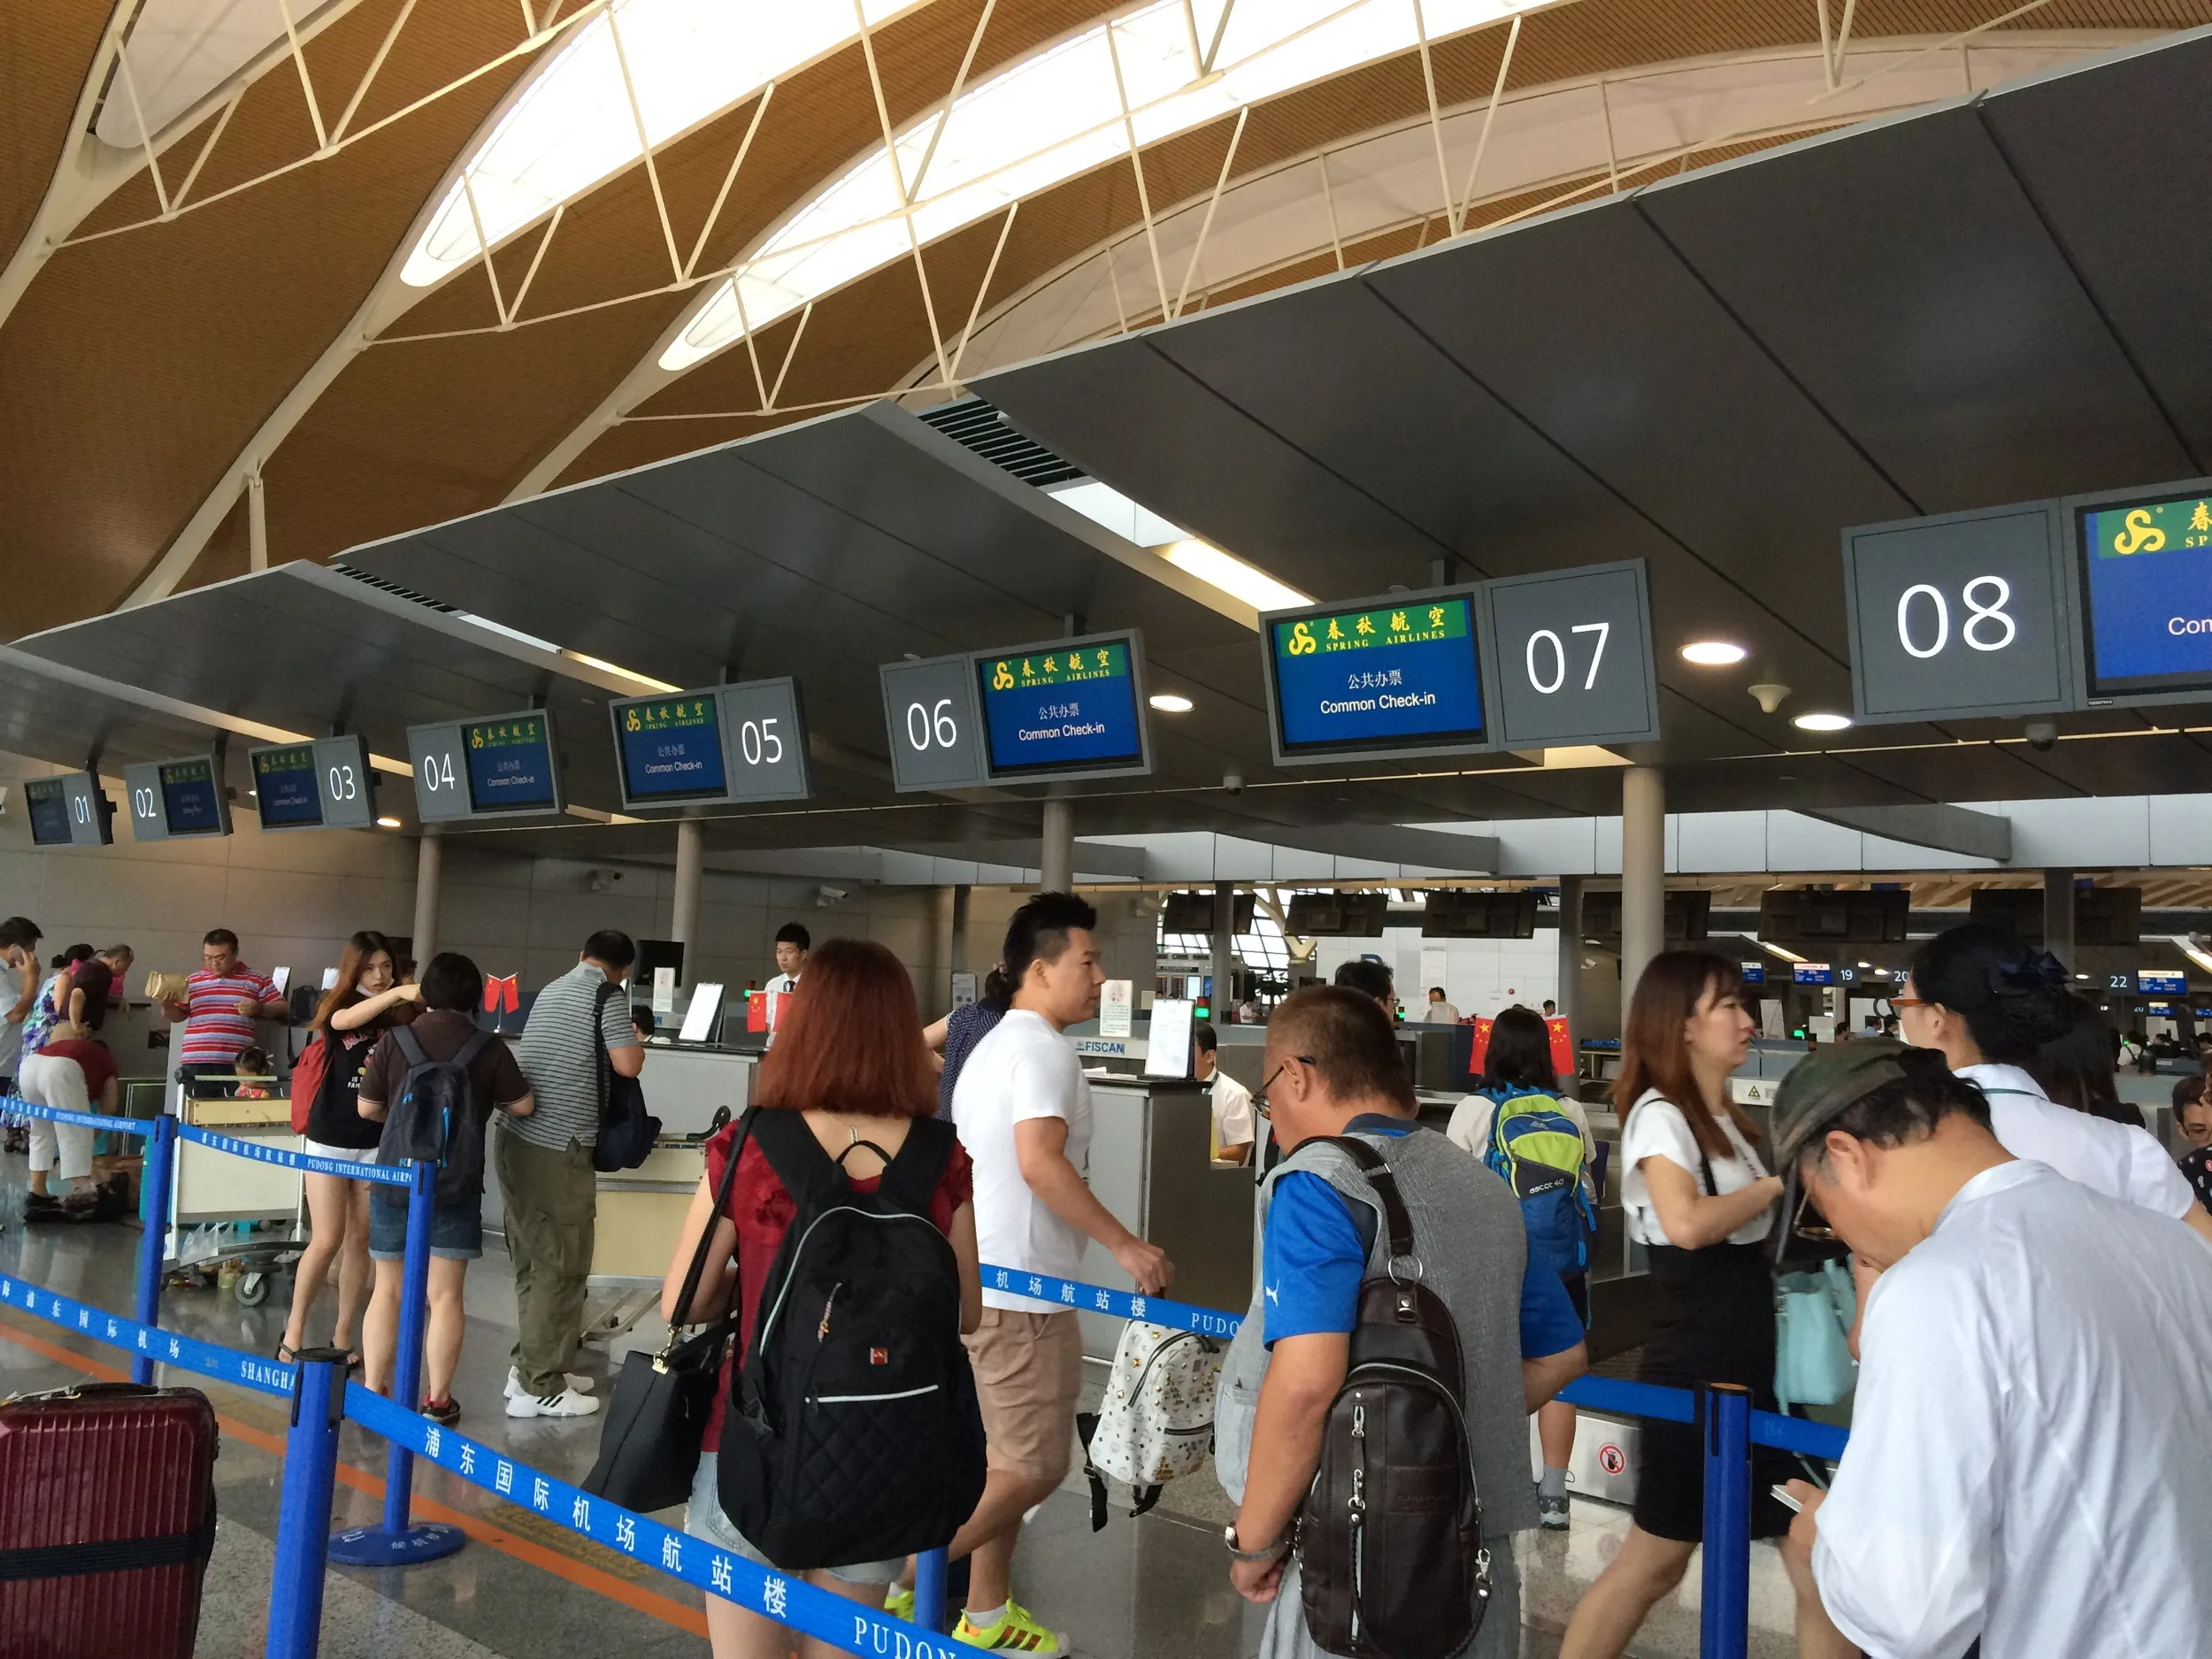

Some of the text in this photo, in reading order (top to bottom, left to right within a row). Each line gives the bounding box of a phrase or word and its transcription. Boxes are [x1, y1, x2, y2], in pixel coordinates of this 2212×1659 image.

[1327, 606, 1446, 640] 春秋航空
[1897, 575, 2016, 658] 08
[1325, 629, 1446, 652] SPRING AIRLINES
[1022, 649, 1110, 677] 春秋航空
[1526, 622, 1609, 695] 07
[1021, 669, 1110, 687] SPRING AIRLINES
[1348, 669, 1402, 690] 公共办票
[1039, 703, 1079, 720] 公共办票
[1320, 691, 1436, 714] Common Check-in
[907, 698, 957, 751] 06
[1018, 722, 1105, 741] Common Check-in
[741, 718, 783, 765] 05
[424, 753, 456, 792] 04
[645, 760, 703, 774] Common Check-in
[329, 765, 356, 801] 03
[74, 795, 90, 825] 01
[135, 787, 157, 818] 02
[1840, 969, 1853, 980] 19
[2110, 976, 2128, 987] 22
[1086, 1041, 1125, 1054] FISCAN
[307, 1158, 334, 1172] PUDONG
[335, 1163, 390, 1180] INTERNATIONAL
[995, 1269, 1147, 1318] 机场航站楼
[425, 1425, 787, 1619] 浦东国际机场航站楼
